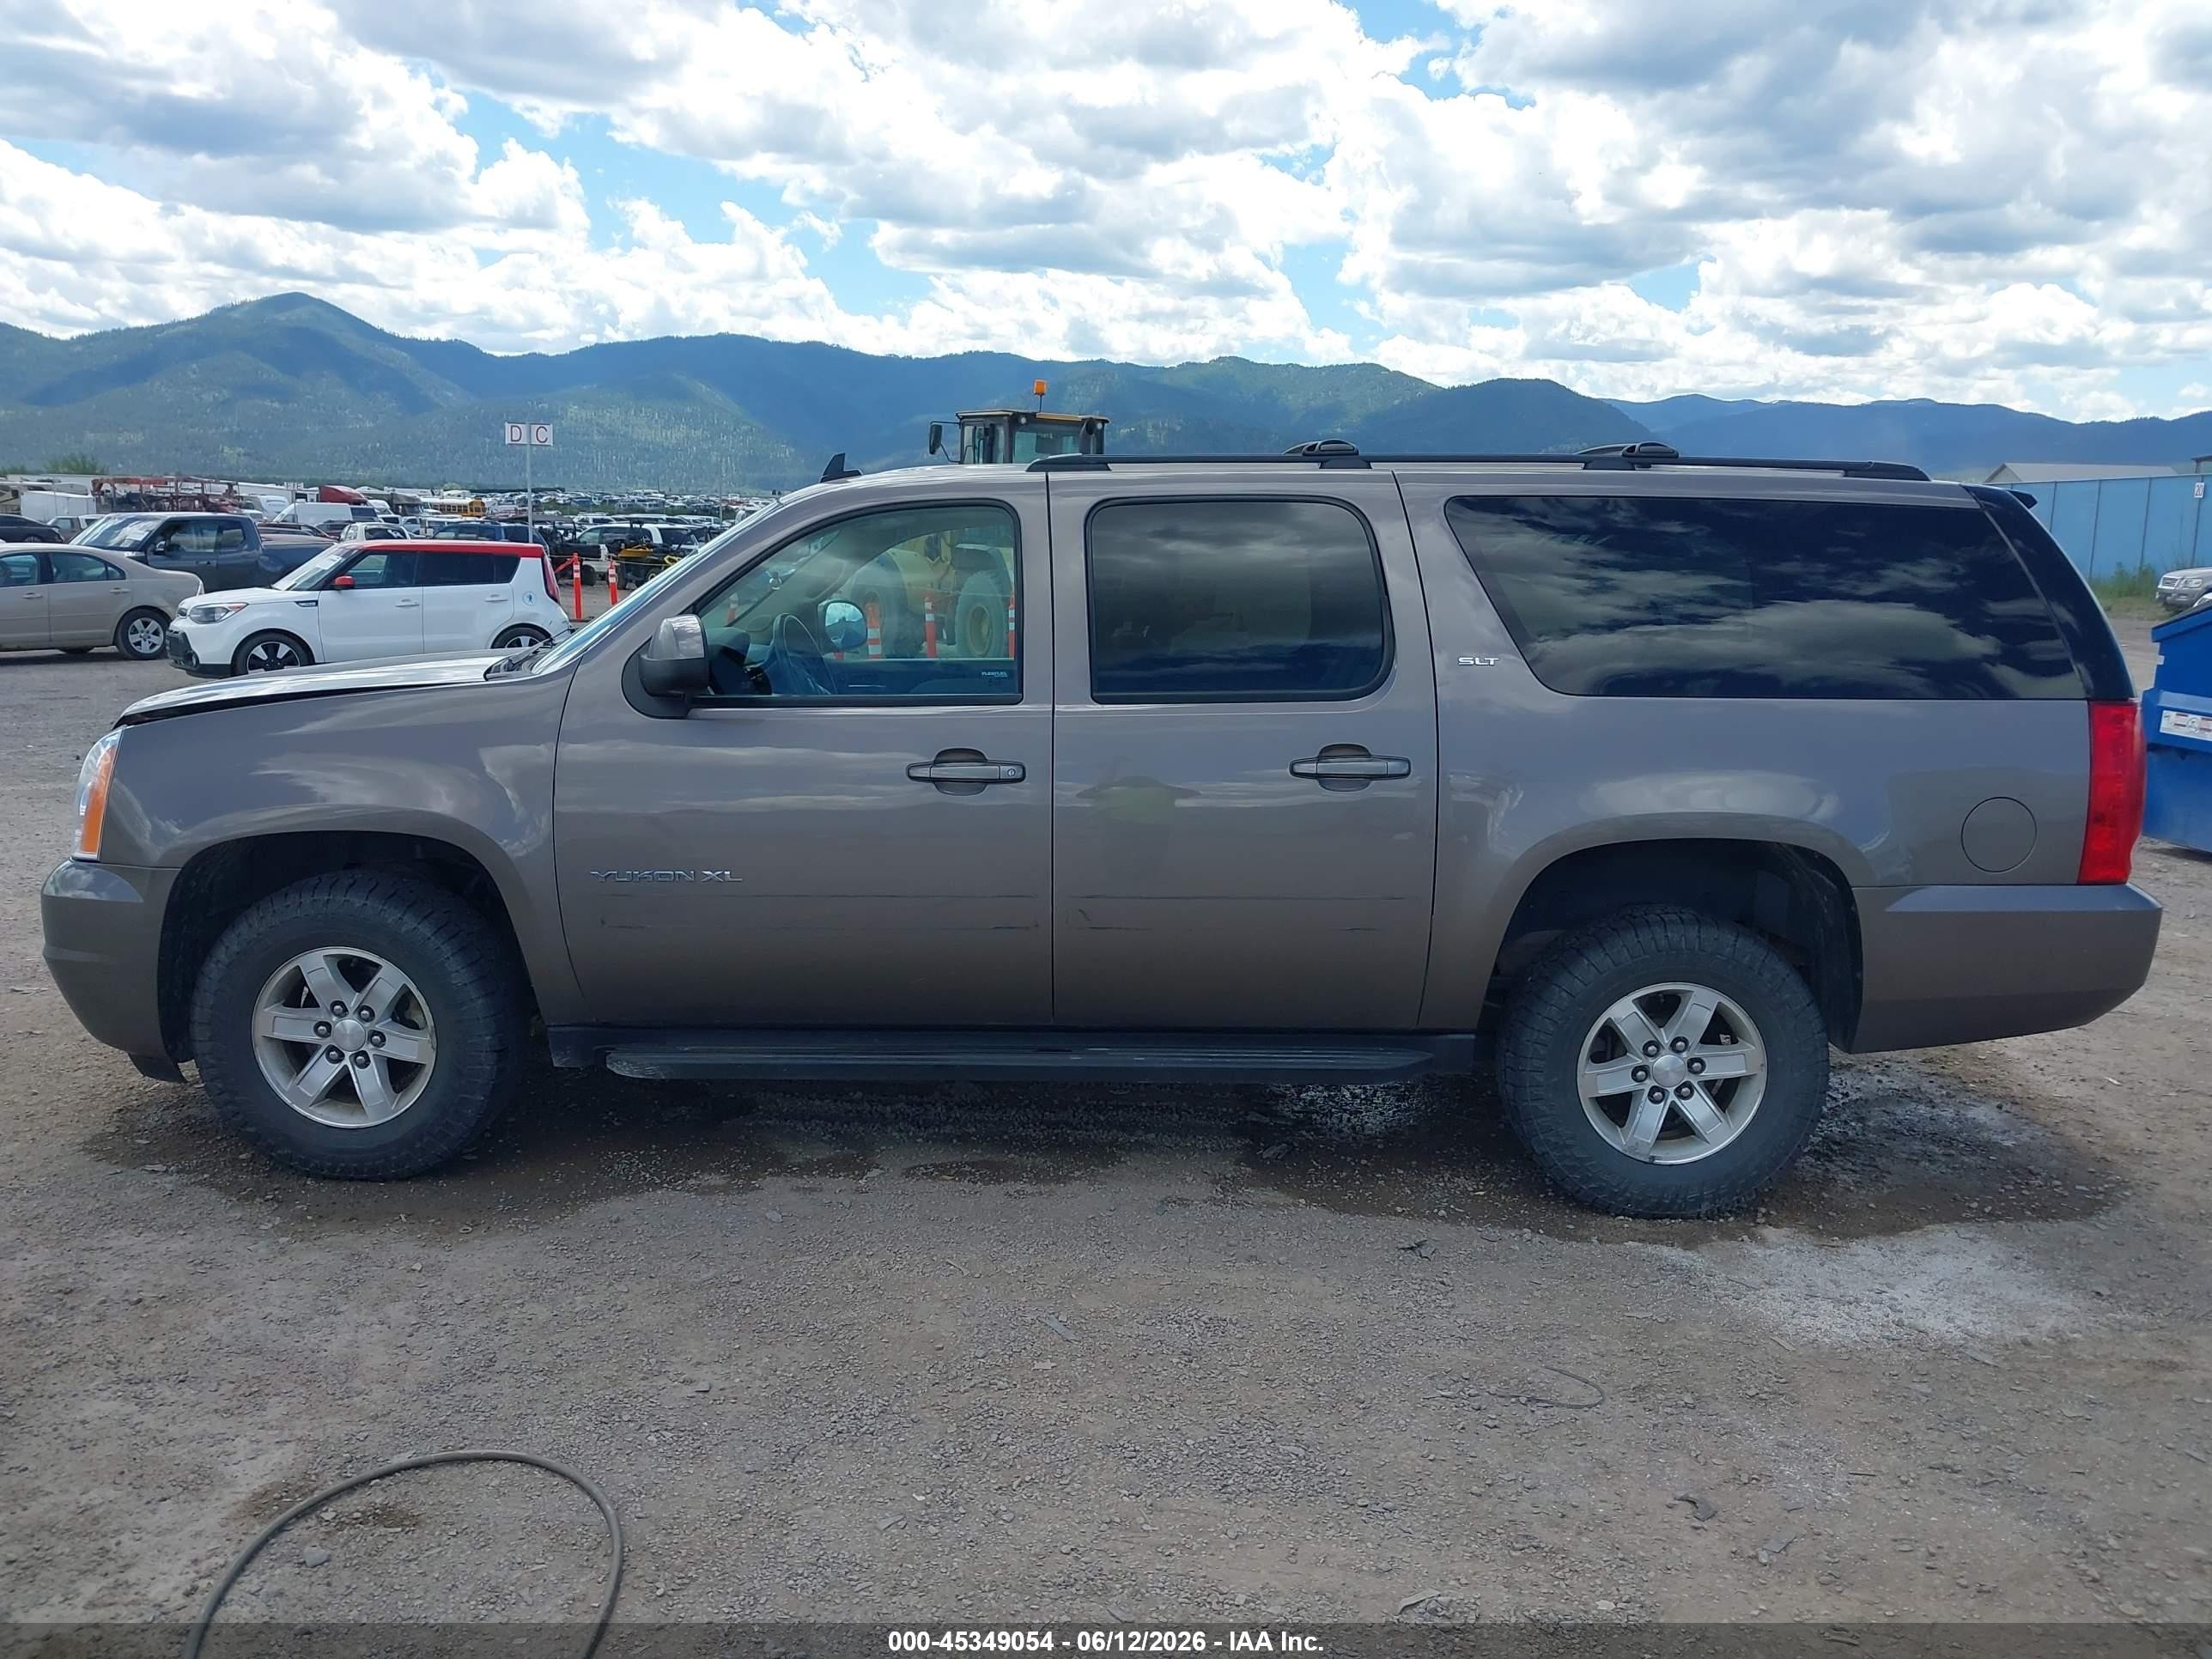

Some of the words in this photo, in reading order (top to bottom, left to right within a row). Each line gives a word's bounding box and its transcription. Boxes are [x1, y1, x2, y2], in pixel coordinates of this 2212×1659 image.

[510, 424, 522, 442] D
[535, 426, 548, 444] C
[1458, 657, 1499, 665] SLT
[589, 870, 695, 882] YUKON
[701, 870, 743, 882] XL
